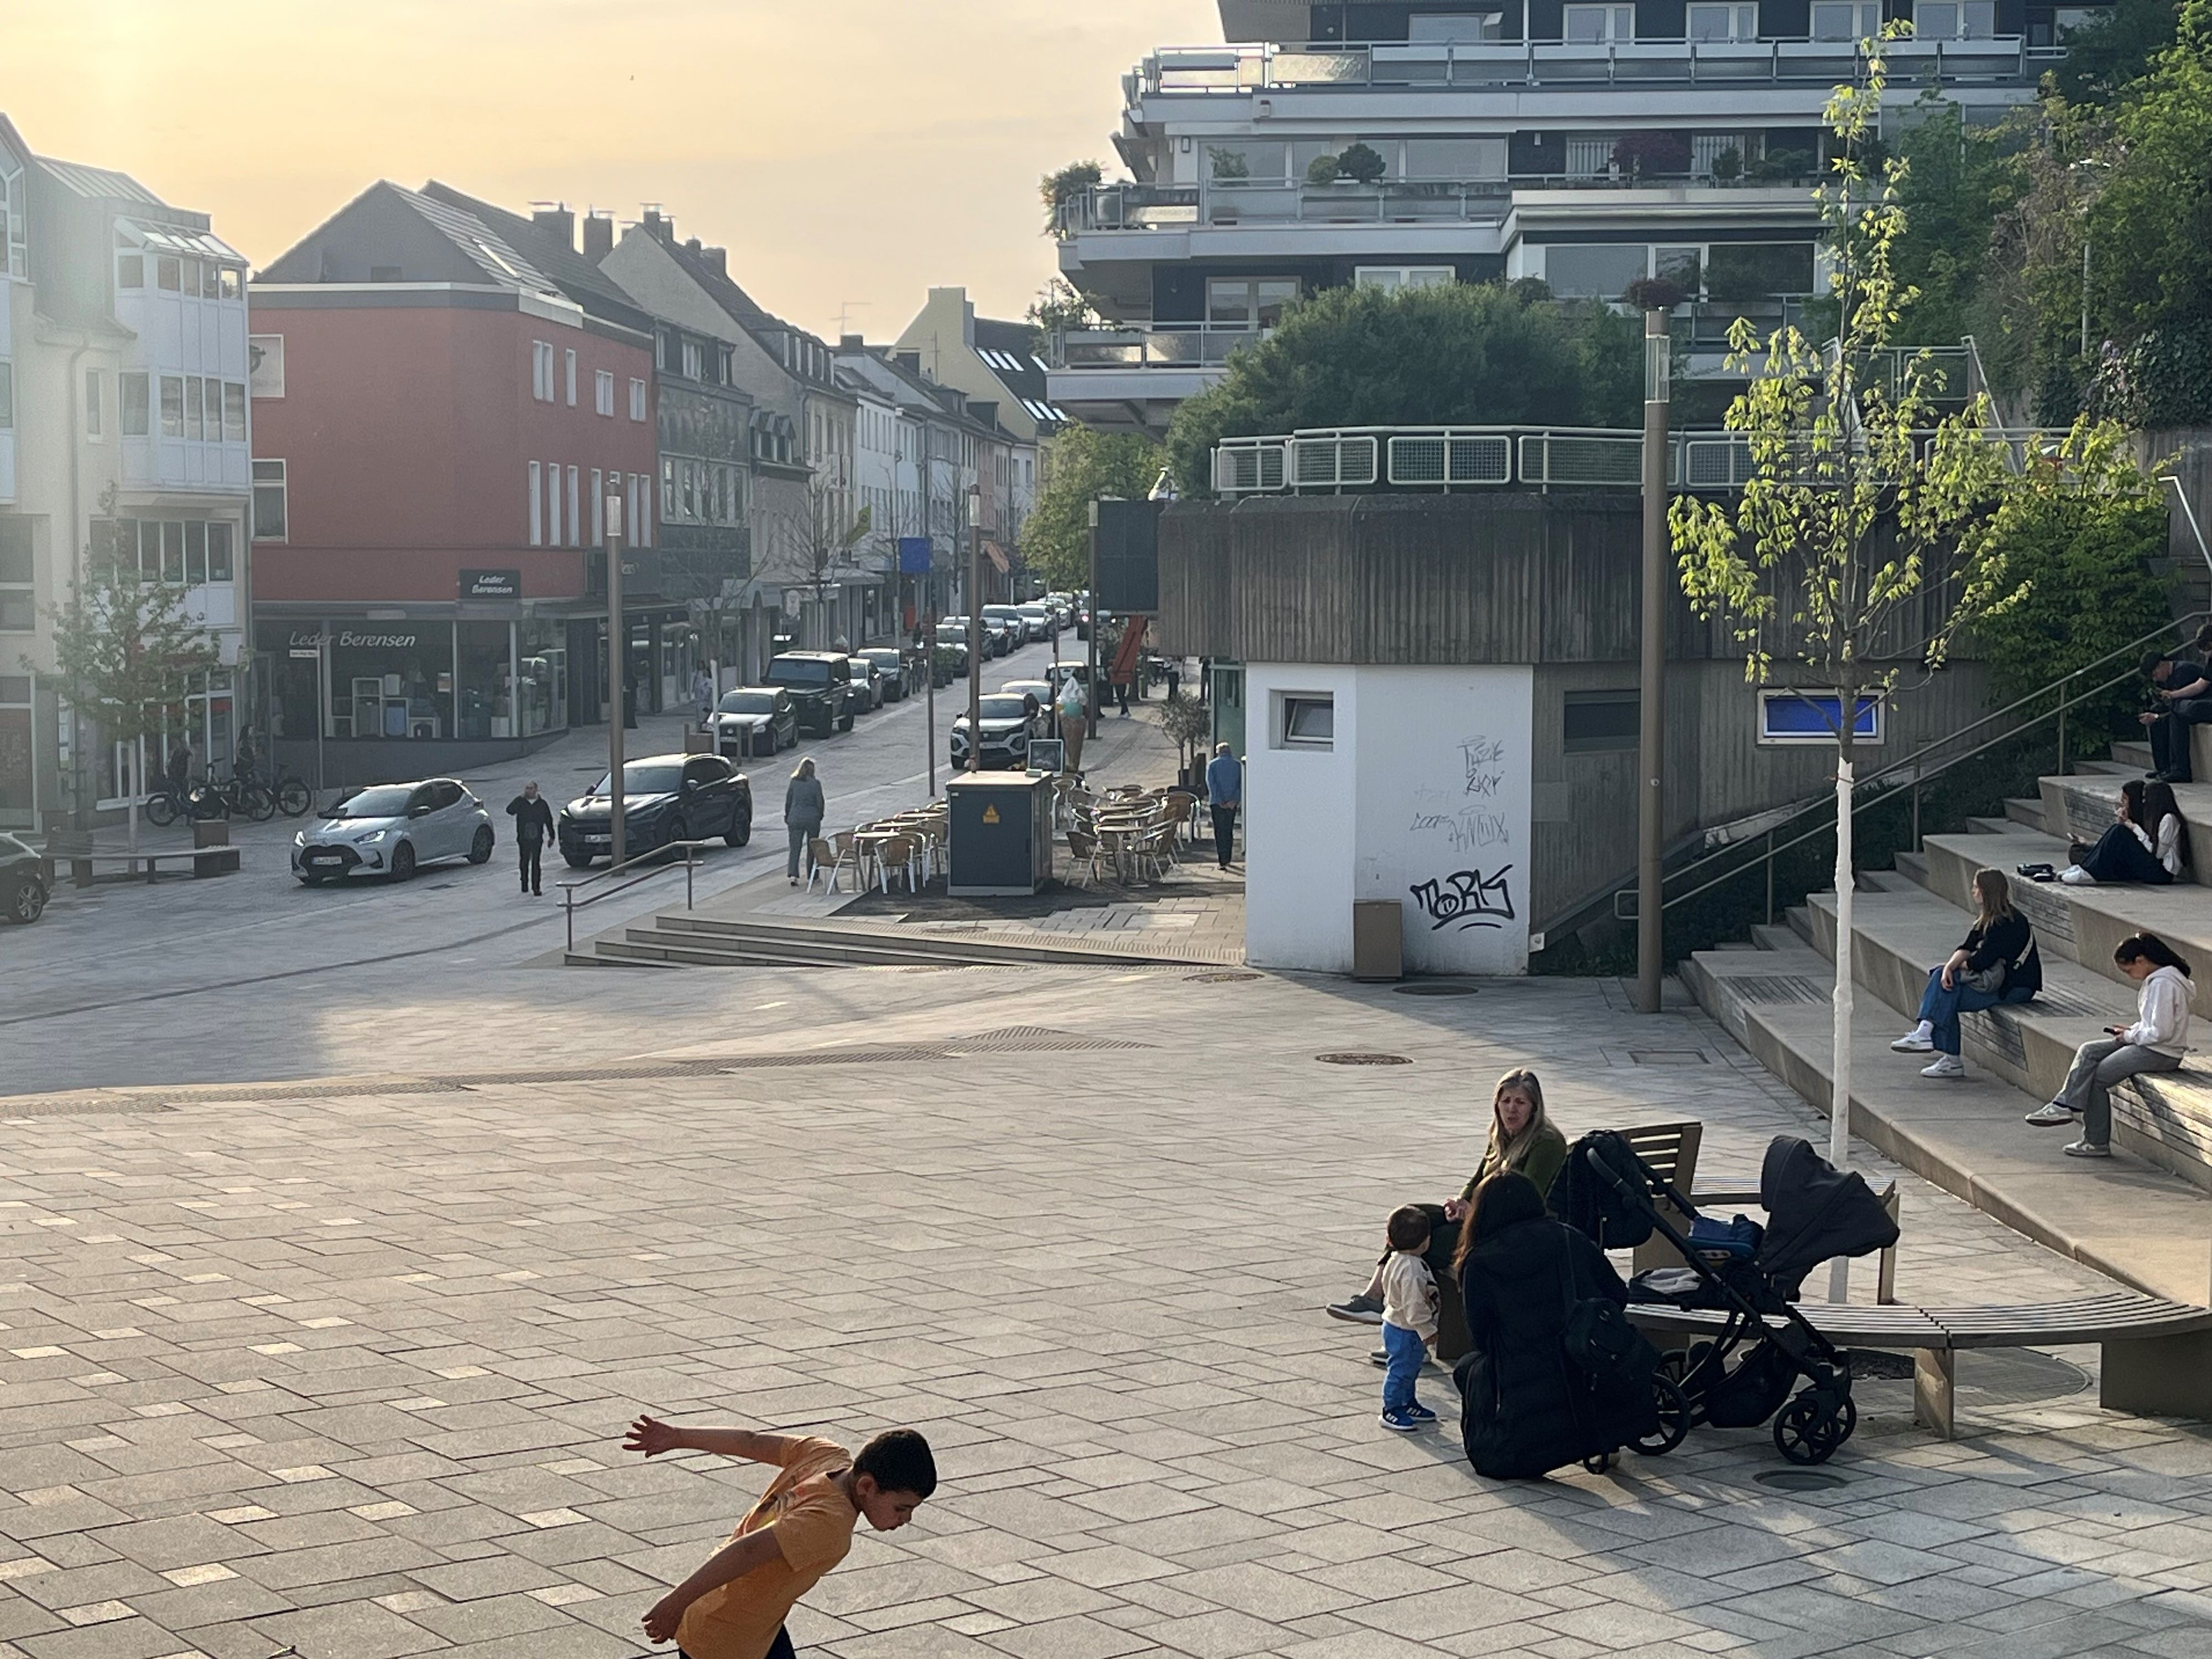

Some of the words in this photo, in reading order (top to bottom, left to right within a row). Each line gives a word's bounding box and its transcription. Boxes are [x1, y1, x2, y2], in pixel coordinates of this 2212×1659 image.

[479, 575, 505, 584] Leder
[472, 585, 513, 594] Berensen
[289, 631, 335, 646] Leder
[340, 631, 415, 647] Berensen
